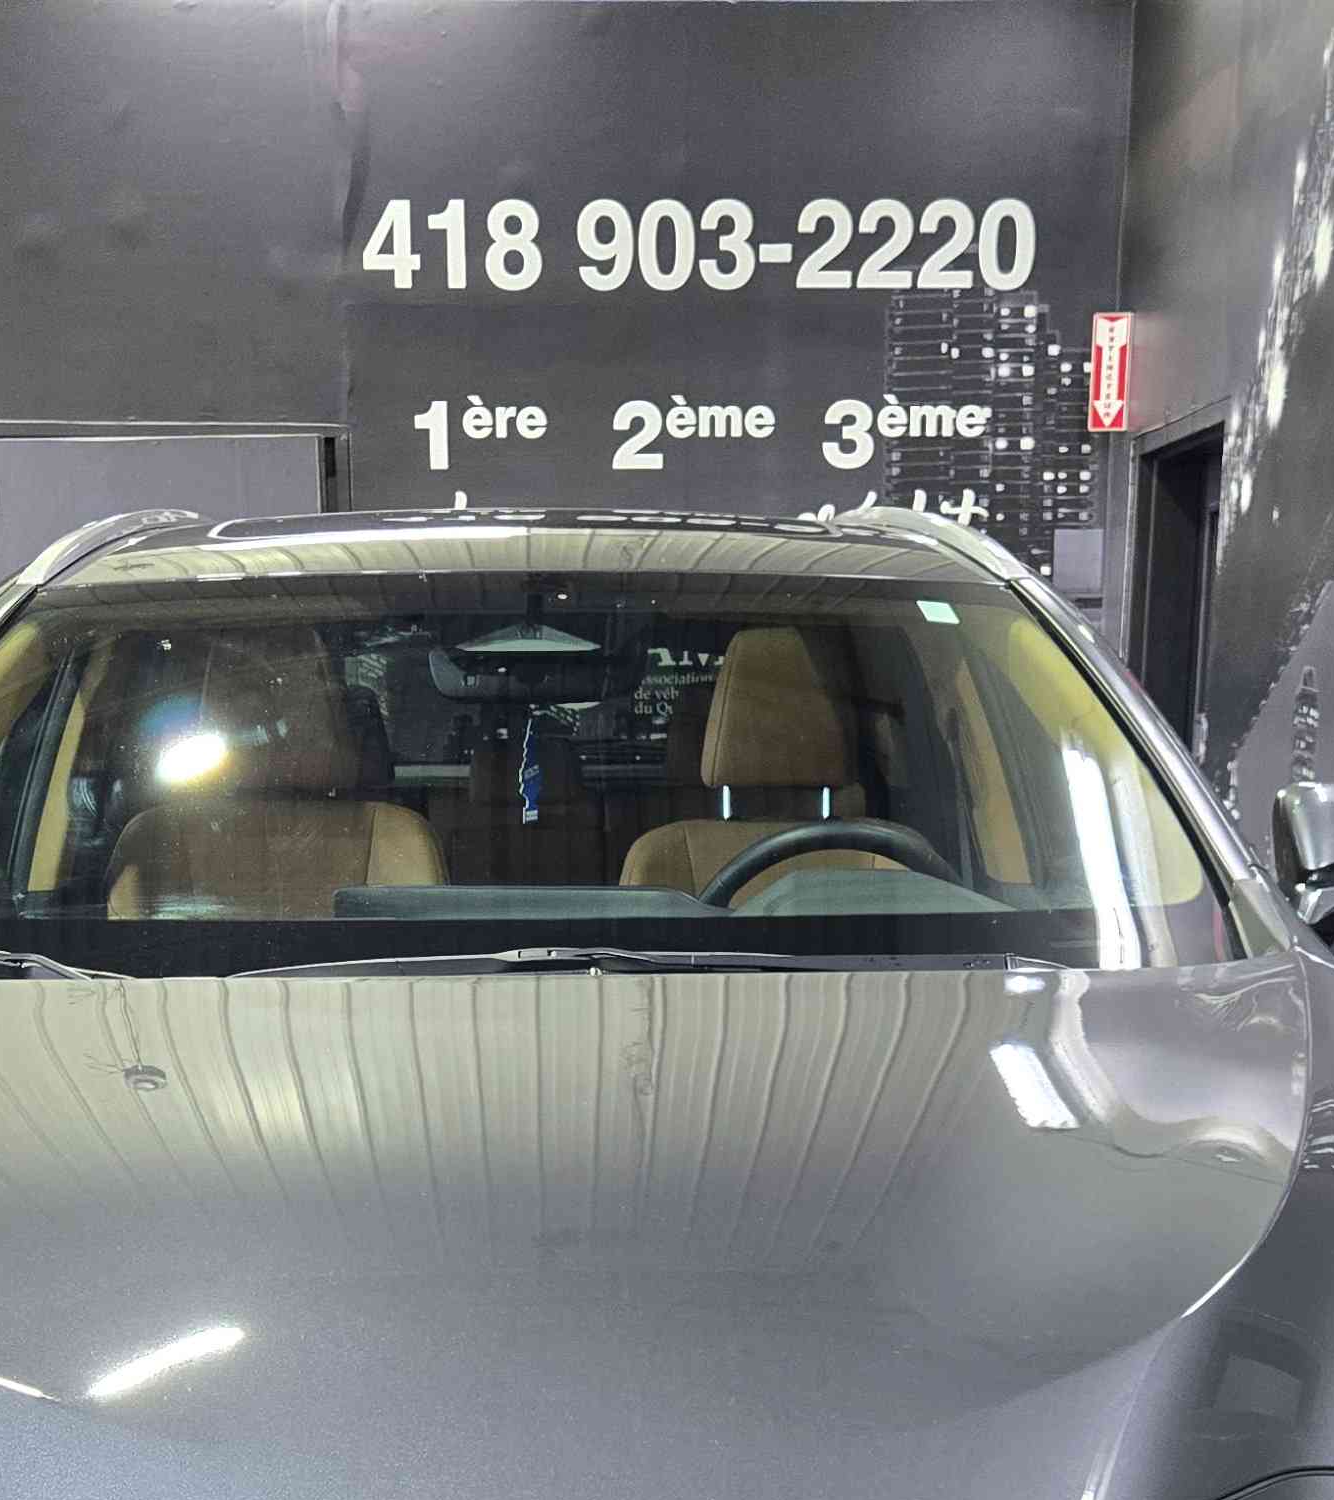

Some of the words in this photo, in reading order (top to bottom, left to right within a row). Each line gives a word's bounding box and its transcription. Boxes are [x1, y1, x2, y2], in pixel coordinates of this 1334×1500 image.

[362, 198, 543, 291] 418
[577, 198, 1036, 292] 903-2220
[414, 395, 547, 470] 1ère
[612, 395, 776, 470] 2ème
[822, 394, 992, 470] 3ème
[641, 672, 714, 685] ssociation
